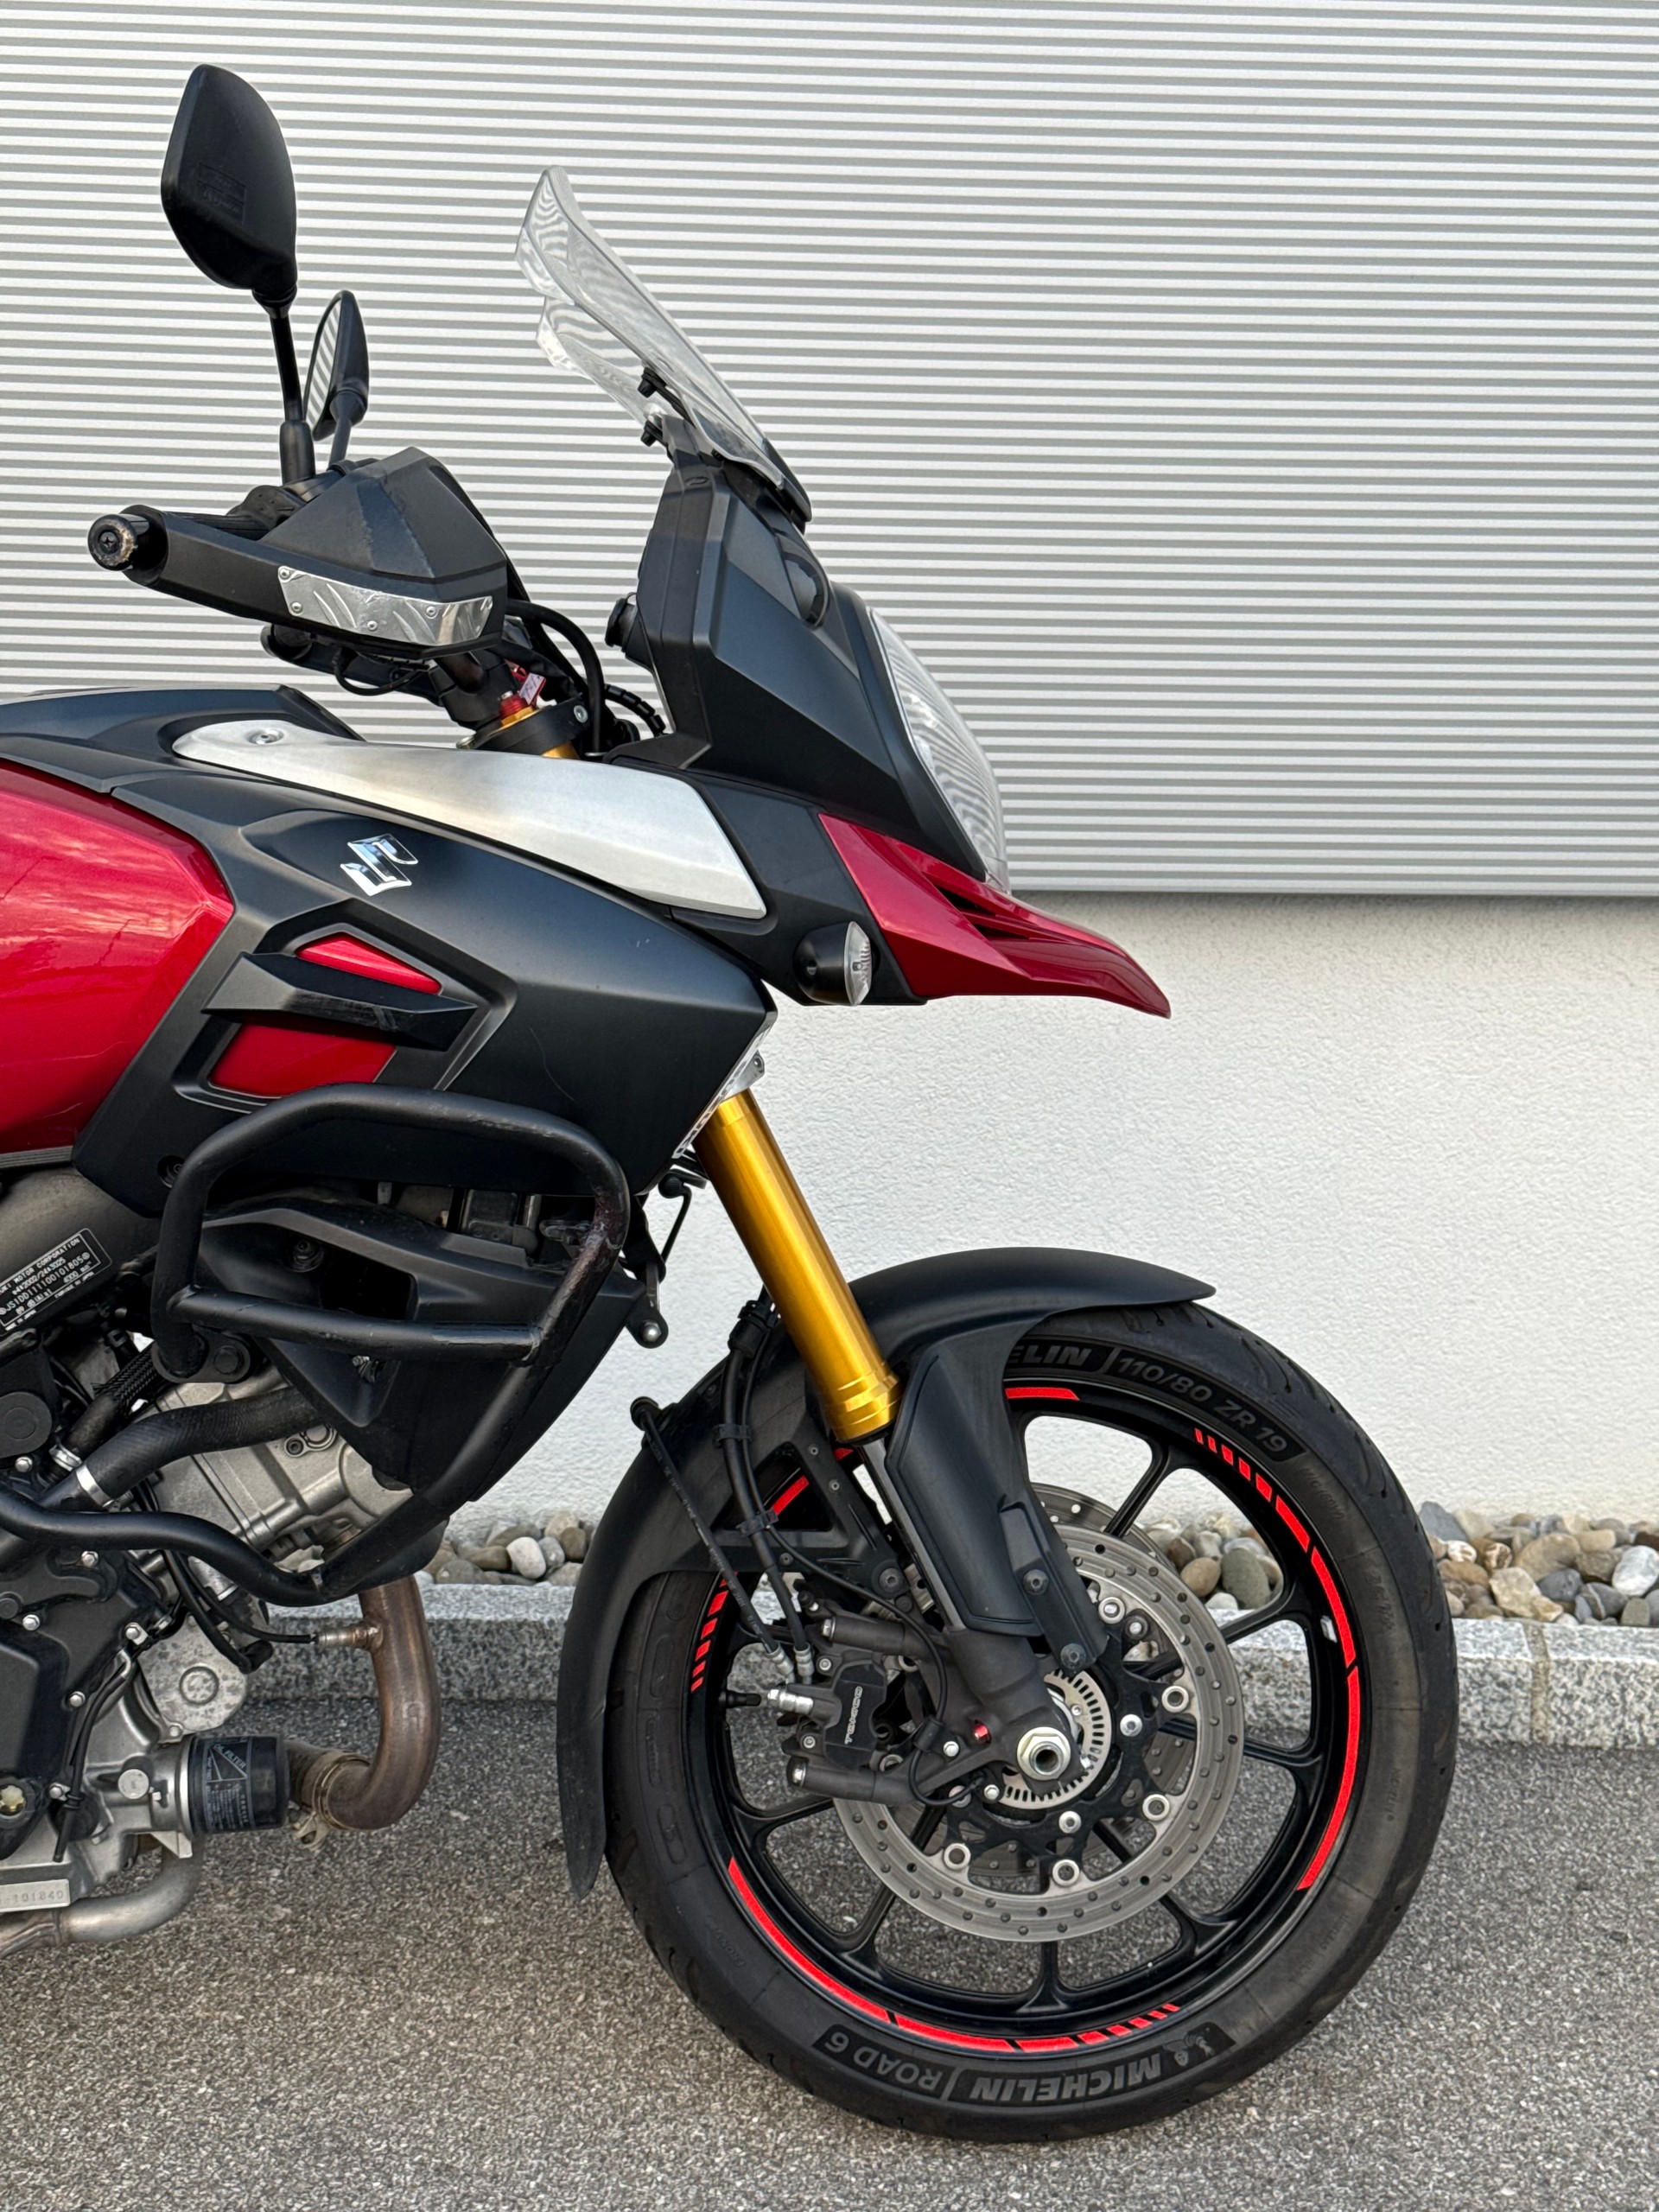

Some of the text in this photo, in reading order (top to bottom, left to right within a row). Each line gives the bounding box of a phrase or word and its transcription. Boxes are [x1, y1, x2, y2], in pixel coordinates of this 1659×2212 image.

[13, 1267, 35, 1284] MOTOR
[36, 1238, 80, 1268] CORPORATION
[1119, 1357, 1288, 1454] 110/80 ZR 19
[844, 1686, 863, 1745] TOKICO
[224, 1749, 247, 1769] FILTER
[824, 2031, 1162, 2101] MICHELIN ROAD 6
